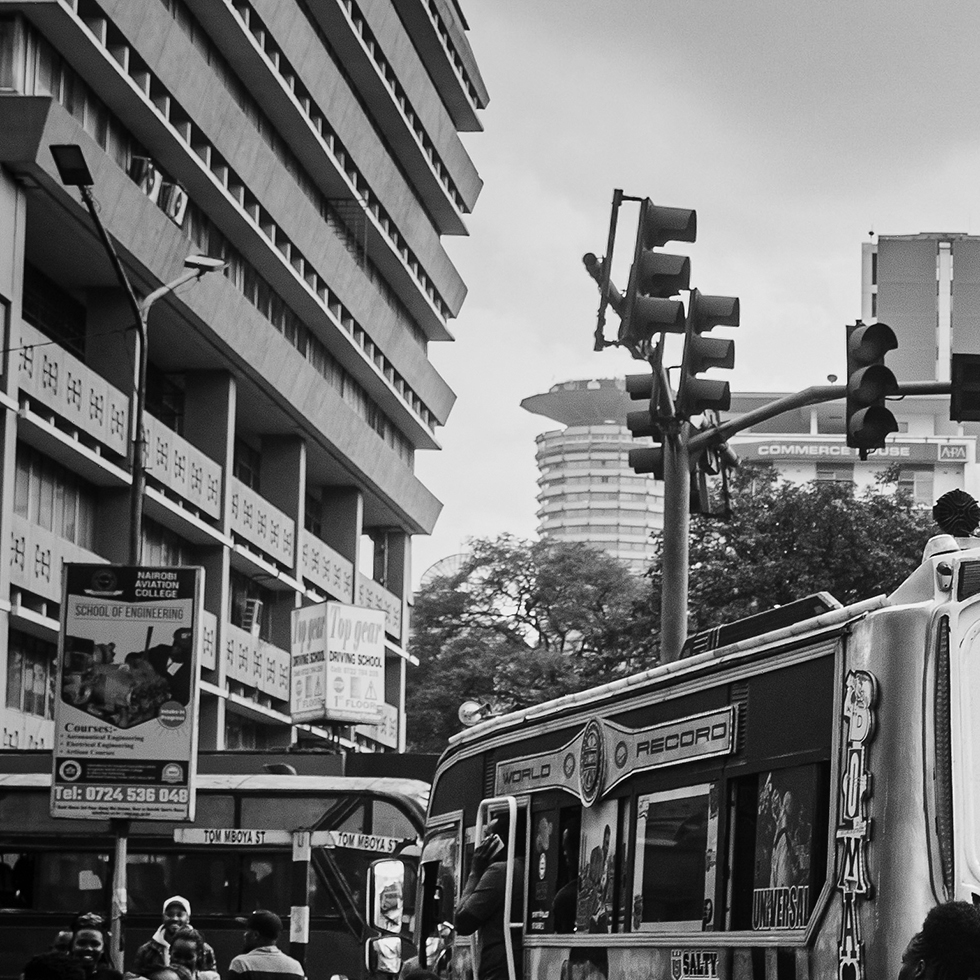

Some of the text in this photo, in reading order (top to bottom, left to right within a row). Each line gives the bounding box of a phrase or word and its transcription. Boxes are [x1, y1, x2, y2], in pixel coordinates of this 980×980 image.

[757, 445, 910, 456] COMMERCE OUSE
[137, 571, 178, 580] NAIROBI
[135, 580, 180, 589] AVIATION
[135, 588, 178, 598] COLLEGE
[75, 605, 184, 620] SCHOOL OF ENGINEERING
[330, 605, 382, 651] Top gear
[329, 650, 383, 668] DRIVING SCHOOL
[64, 722, 118, 733] Courses:-
[502, 723, 727, 785] WORLD RECORD
[55, 785, 189, 803] Tel: 0724 536 048
[203, 830, 266, 843] TOM MBOYA ST
[338, 832, 399, 851] TOM MBOYA ST
[751, 885, 810, 930] UNIVERSAL
[682, 951, 719, 977] SALTY
